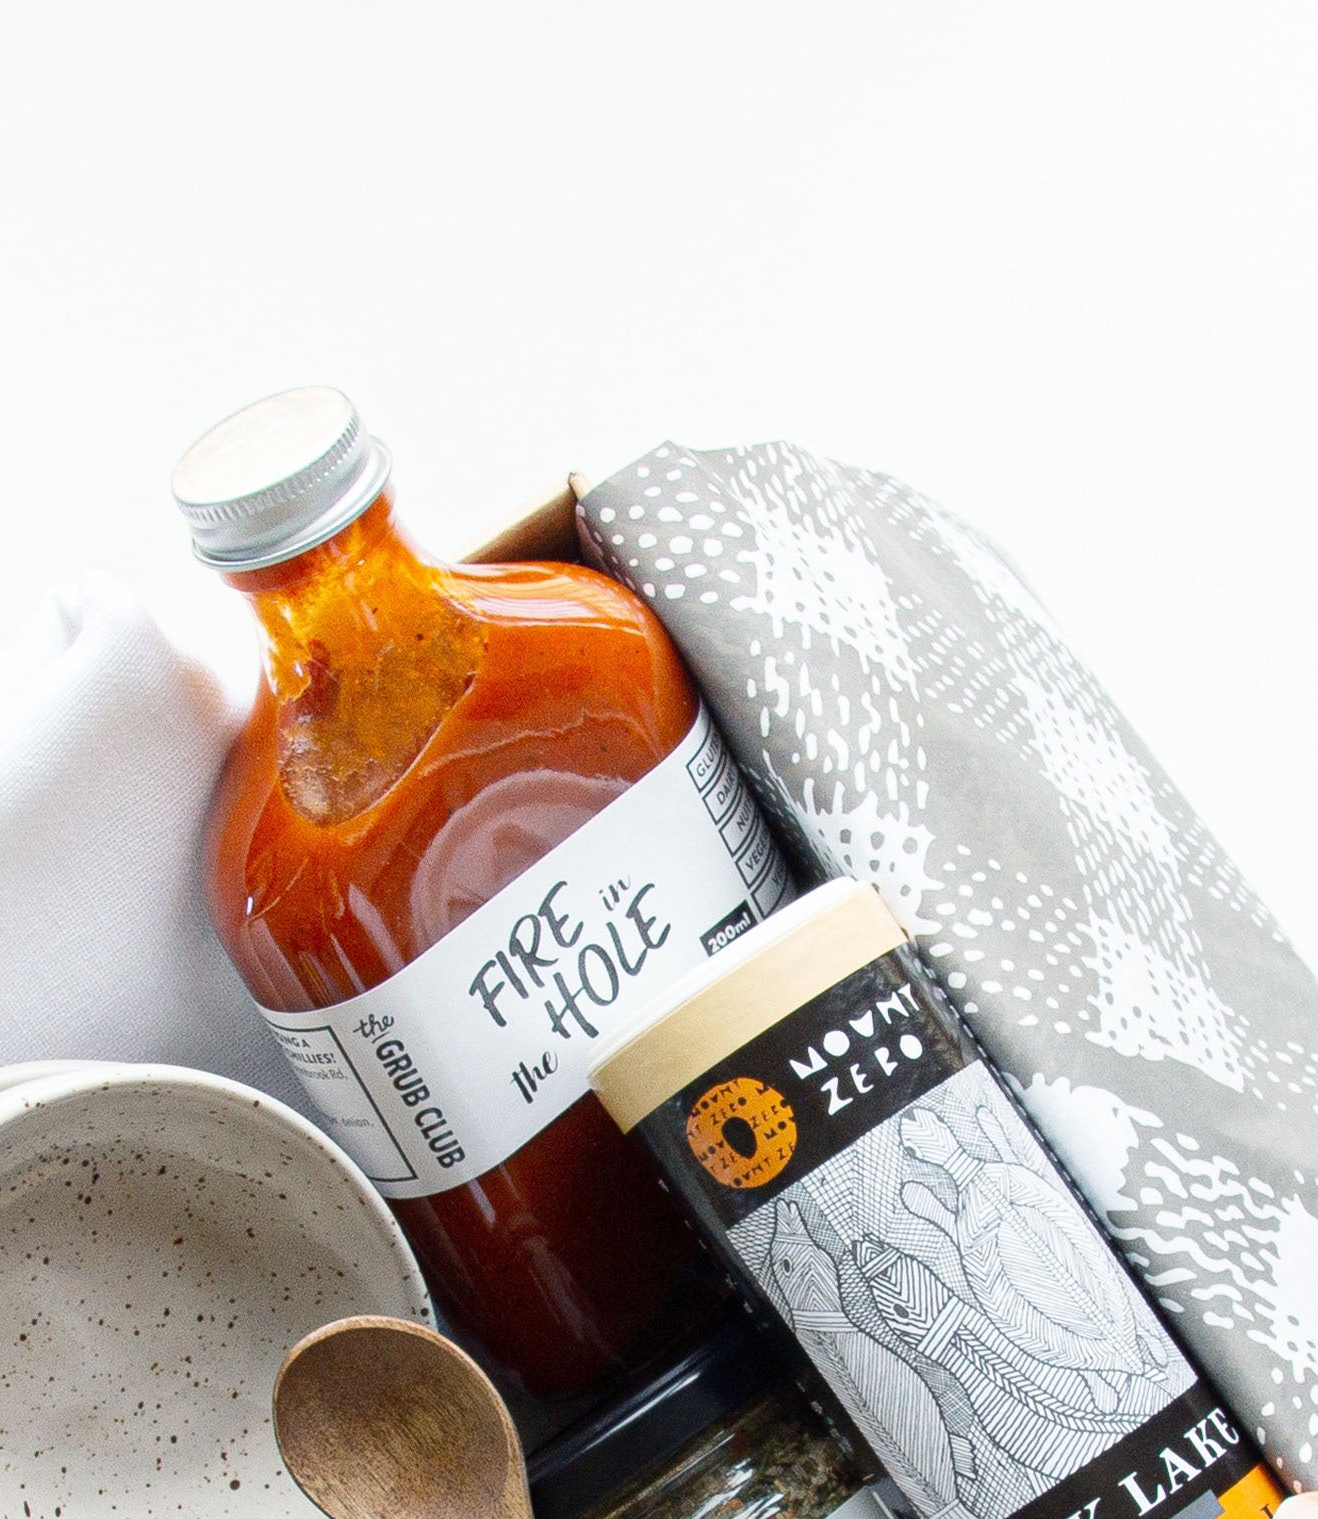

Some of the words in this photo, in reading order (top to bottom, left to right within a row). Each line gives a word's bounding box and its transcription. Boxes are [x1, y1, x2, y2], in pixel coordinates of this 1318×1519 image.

[468, 880, 584, 1028] FIRE
[598, 873, 633, 913] in
[707, 911, 751, 954] 200ml
[352, 1013, 395, 1038] the
[510, 1049, 559, 1104] the
[544, 882, 672, 1040] HOLE
[375, 1039, 431, 1108] GRUB
[413, 1107, 466, 1169] CLUB
[820, 1034, 923, 1116] ZERO
[1118, 1406, 1241, 1518] LAKE
